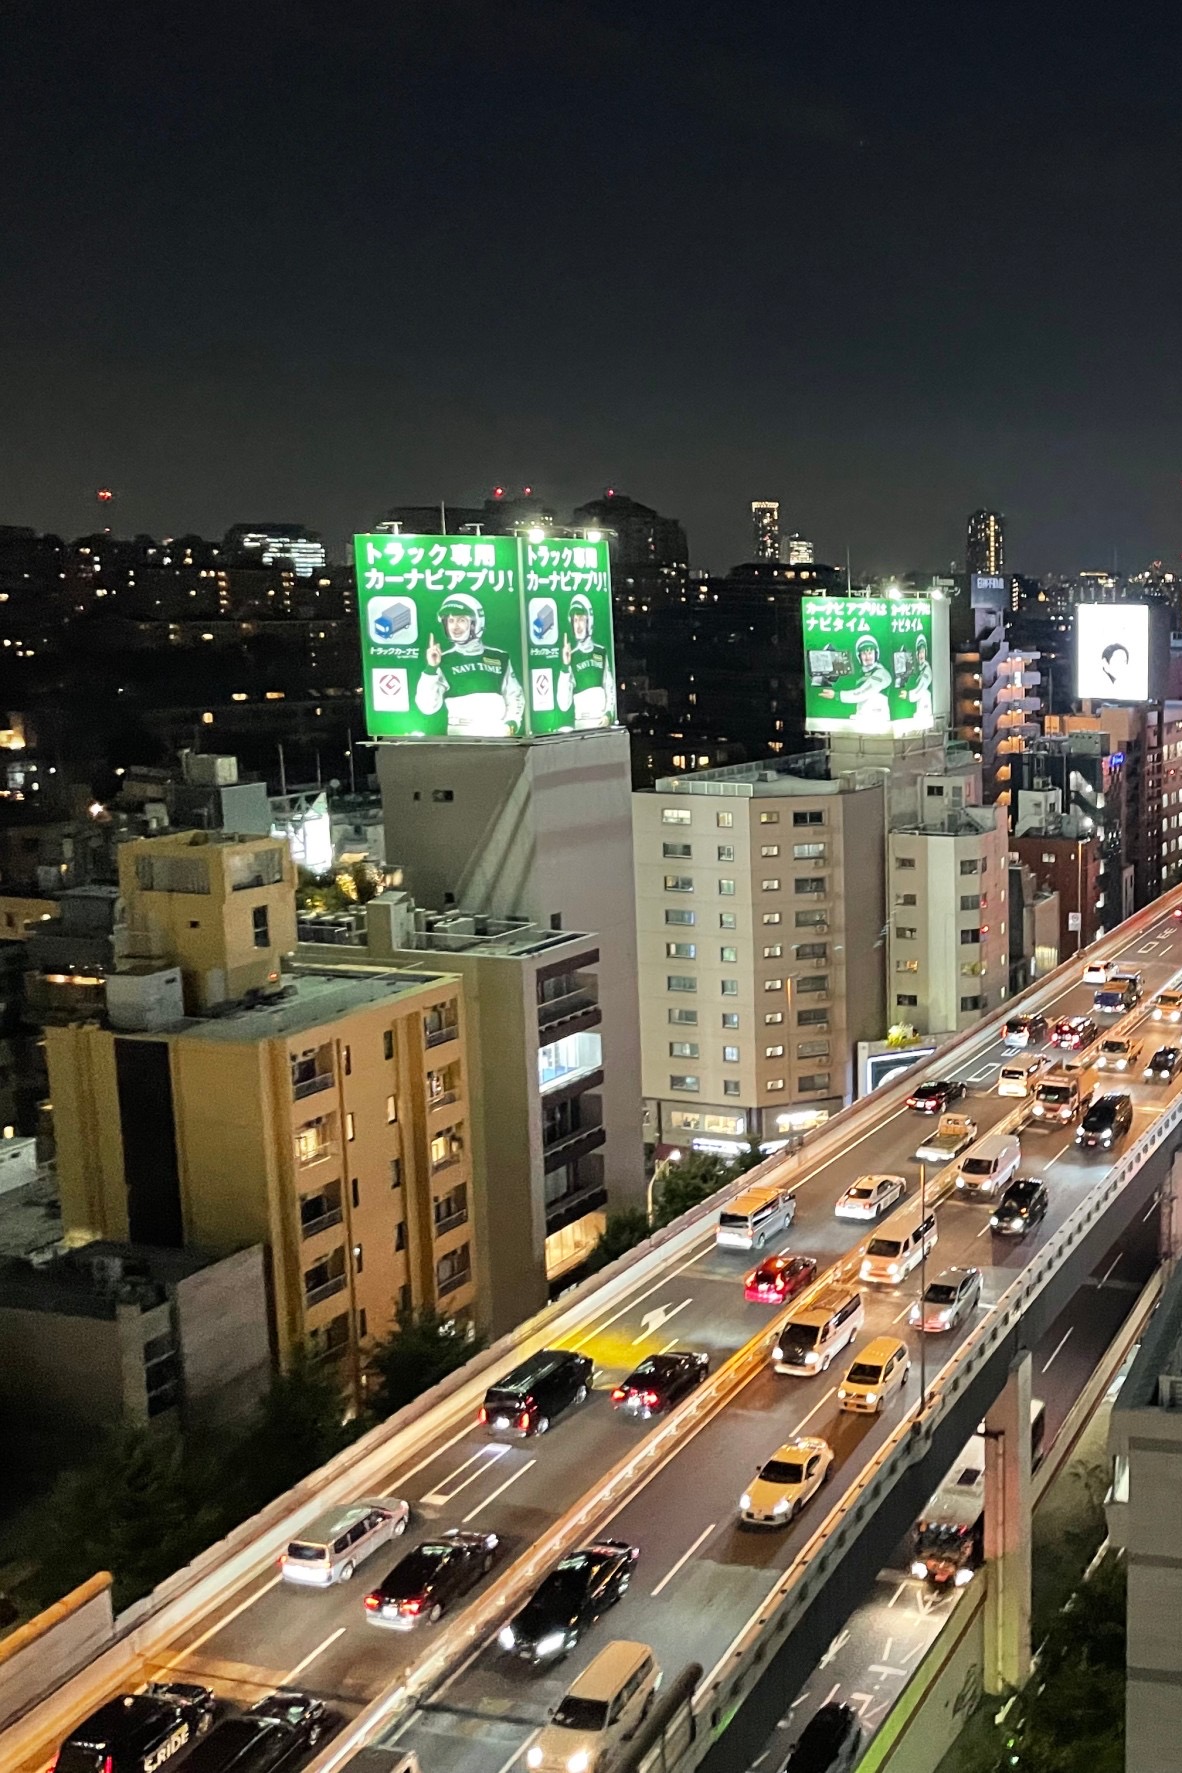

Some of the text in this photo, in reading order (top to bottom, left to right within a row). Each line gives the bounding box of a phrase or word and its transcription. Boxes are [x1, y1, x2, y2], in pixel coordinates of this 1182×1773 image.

[366, 542, 495, 566] トラック専用
[528, 544, 597, 568] トラック専用
[807, 617, 870, 632] ナビタイム
[891, 618, 923, 633] ナビタイム
